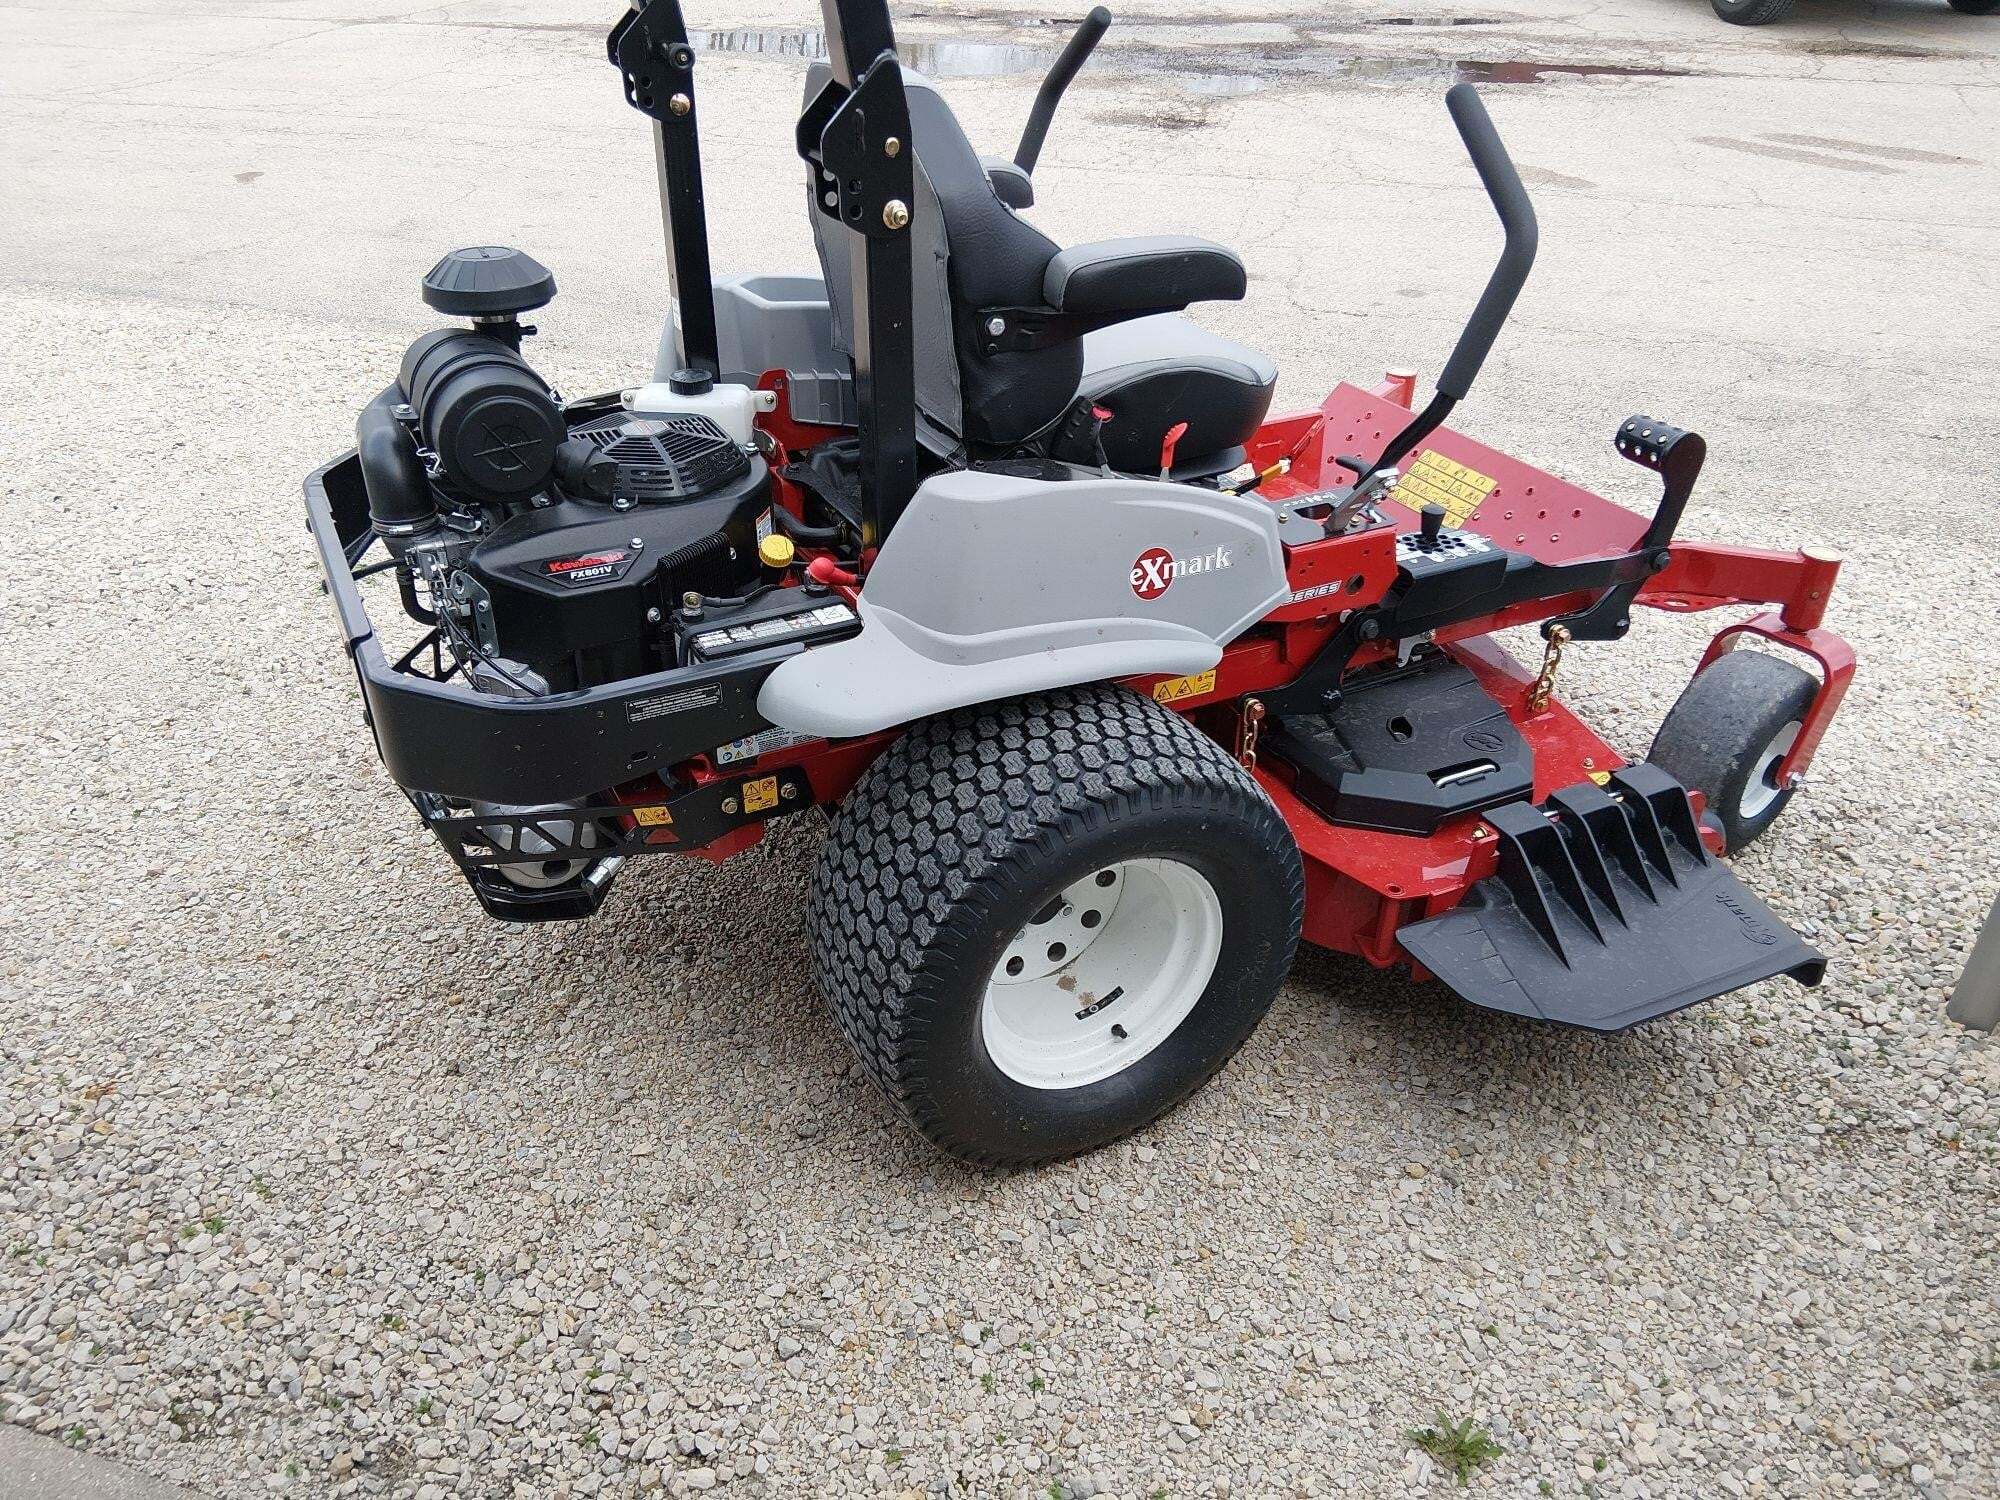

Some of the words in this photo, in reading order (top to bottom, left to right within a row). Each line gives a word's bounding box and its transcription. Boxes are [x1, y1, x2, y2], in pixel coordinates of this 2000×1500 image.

[570, 565, 612, 579] FX801V
[1129, 545, 1232, 592] eXmark
[1287, 582, 1338, 602] SERIES
